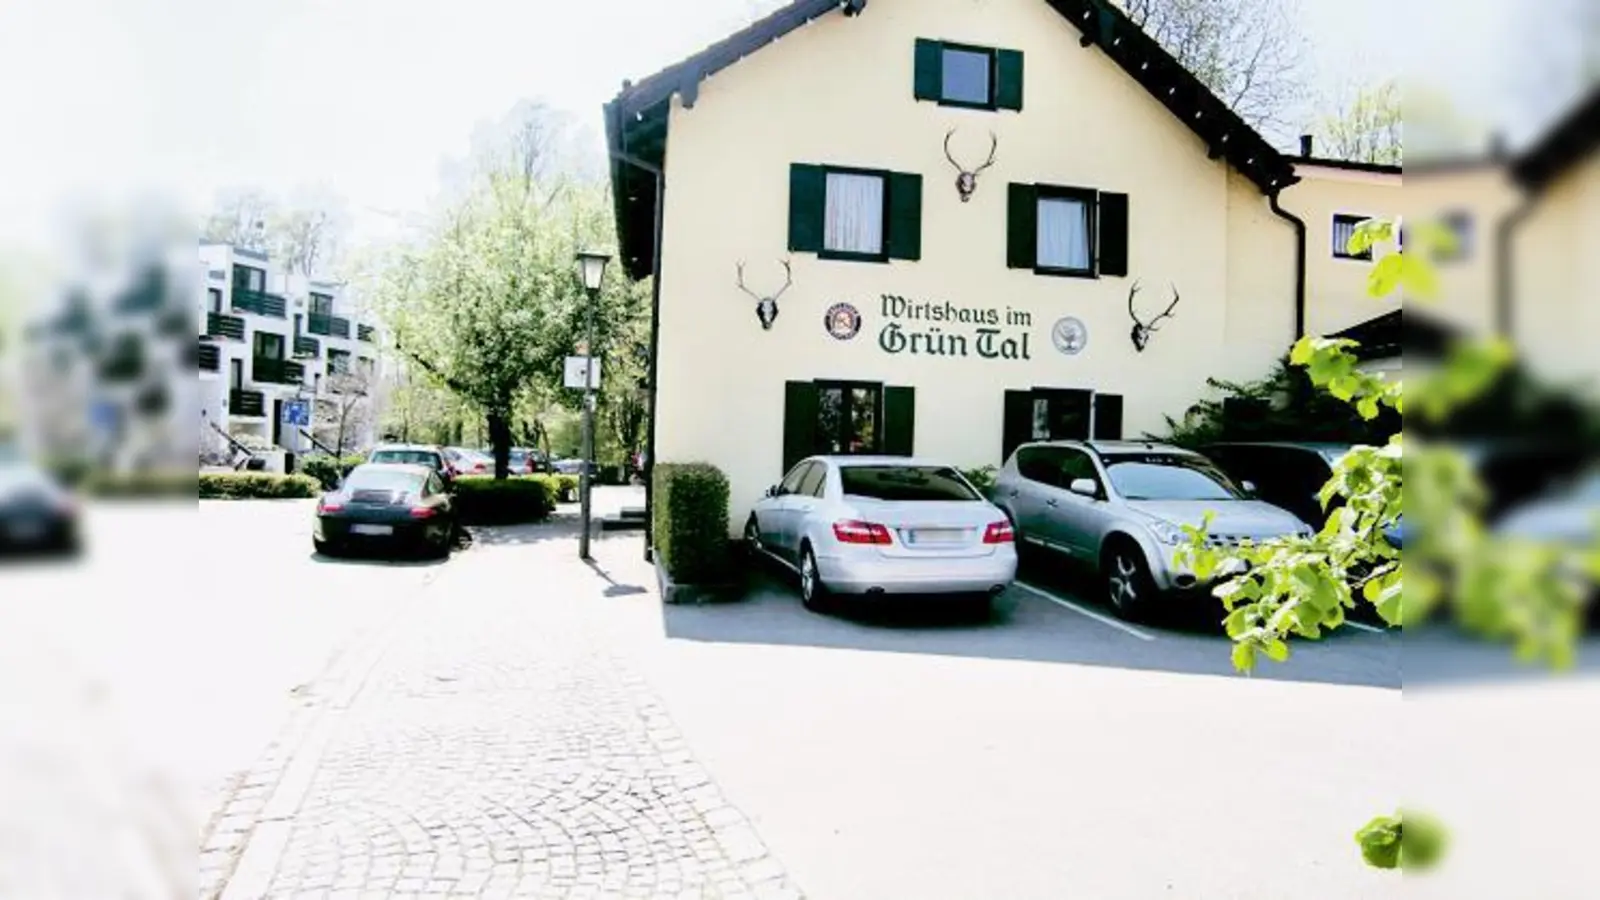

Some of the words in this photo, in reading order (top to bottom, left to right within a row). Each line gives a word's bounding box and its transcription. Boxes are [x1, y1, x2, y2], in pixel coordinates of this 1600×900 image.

[880, 293, 999, 325] Wirtshaus
[1006, 305, 1032, 326] im
[878, 321, 968, 356] Grün
[975, 328, 1031, 360] Tal
